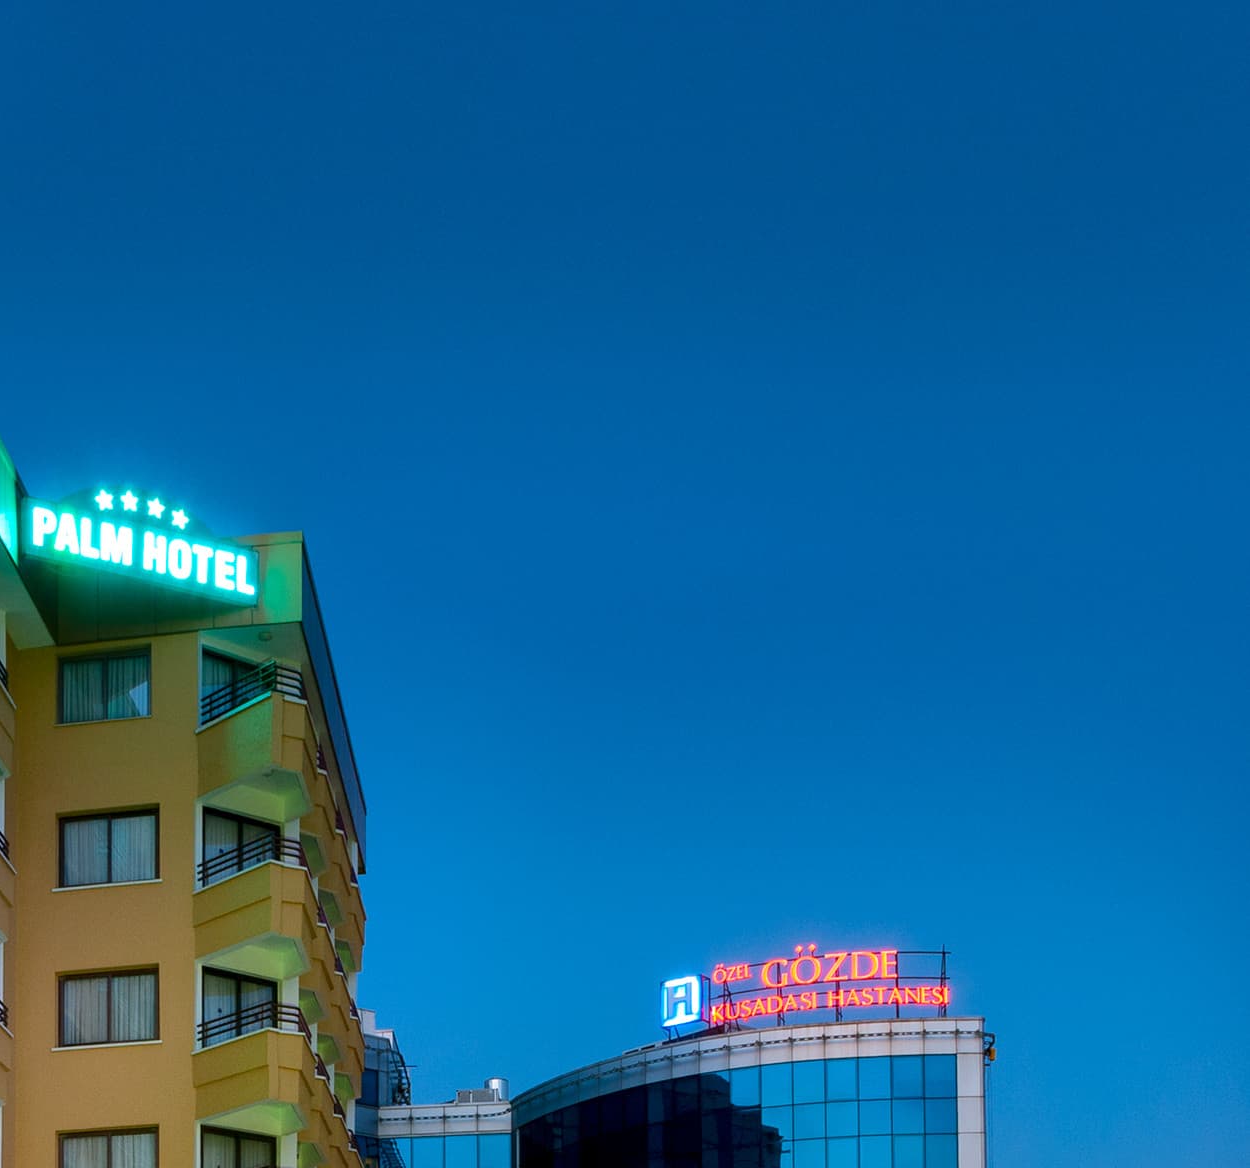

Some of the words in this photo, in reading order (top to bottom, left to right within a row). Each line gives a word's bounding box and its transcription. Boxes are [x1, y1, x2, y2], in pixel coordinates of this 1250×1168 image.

[32, 506, 133, 566] PALM
[143, 530, 255, 595] HOTEL
[712, 963, 751, 984] ÖZEL
[761, 944, 898, 988] GÖZDE
